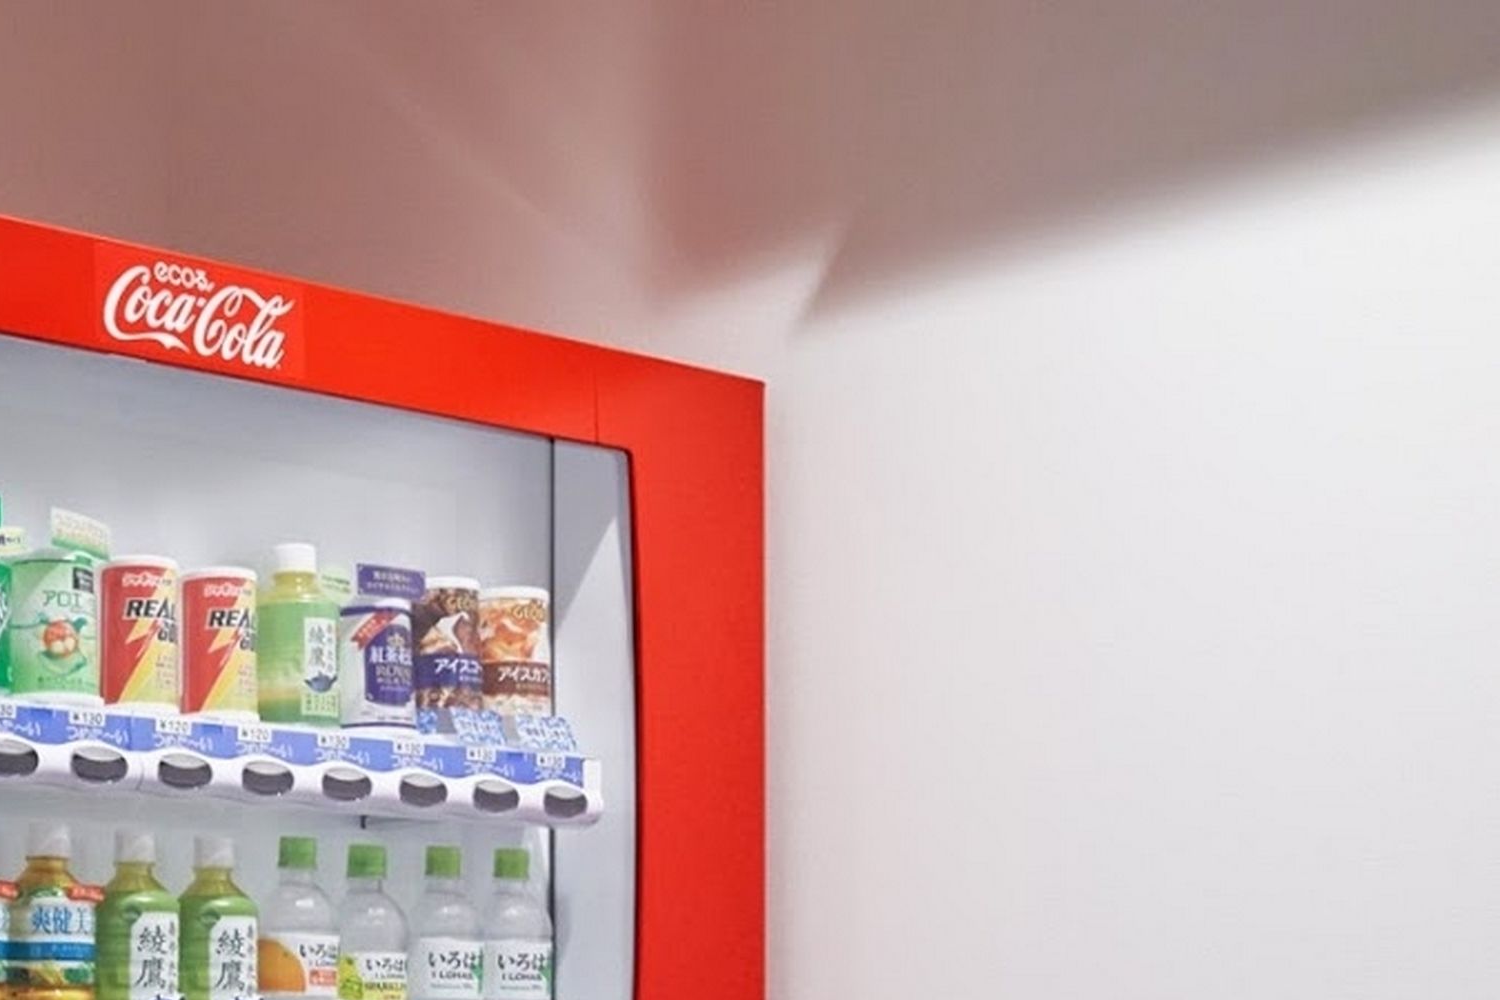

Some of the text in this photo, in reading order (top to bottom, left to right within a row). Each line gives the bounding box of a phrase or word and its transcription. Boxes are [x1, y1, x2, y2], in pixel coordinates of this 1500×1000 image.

[103, 265, 295, 369] Coca-Cola
[135, 924, 167, 990] 綾鷹
[215, 928, 246, 992] 綾鷹
